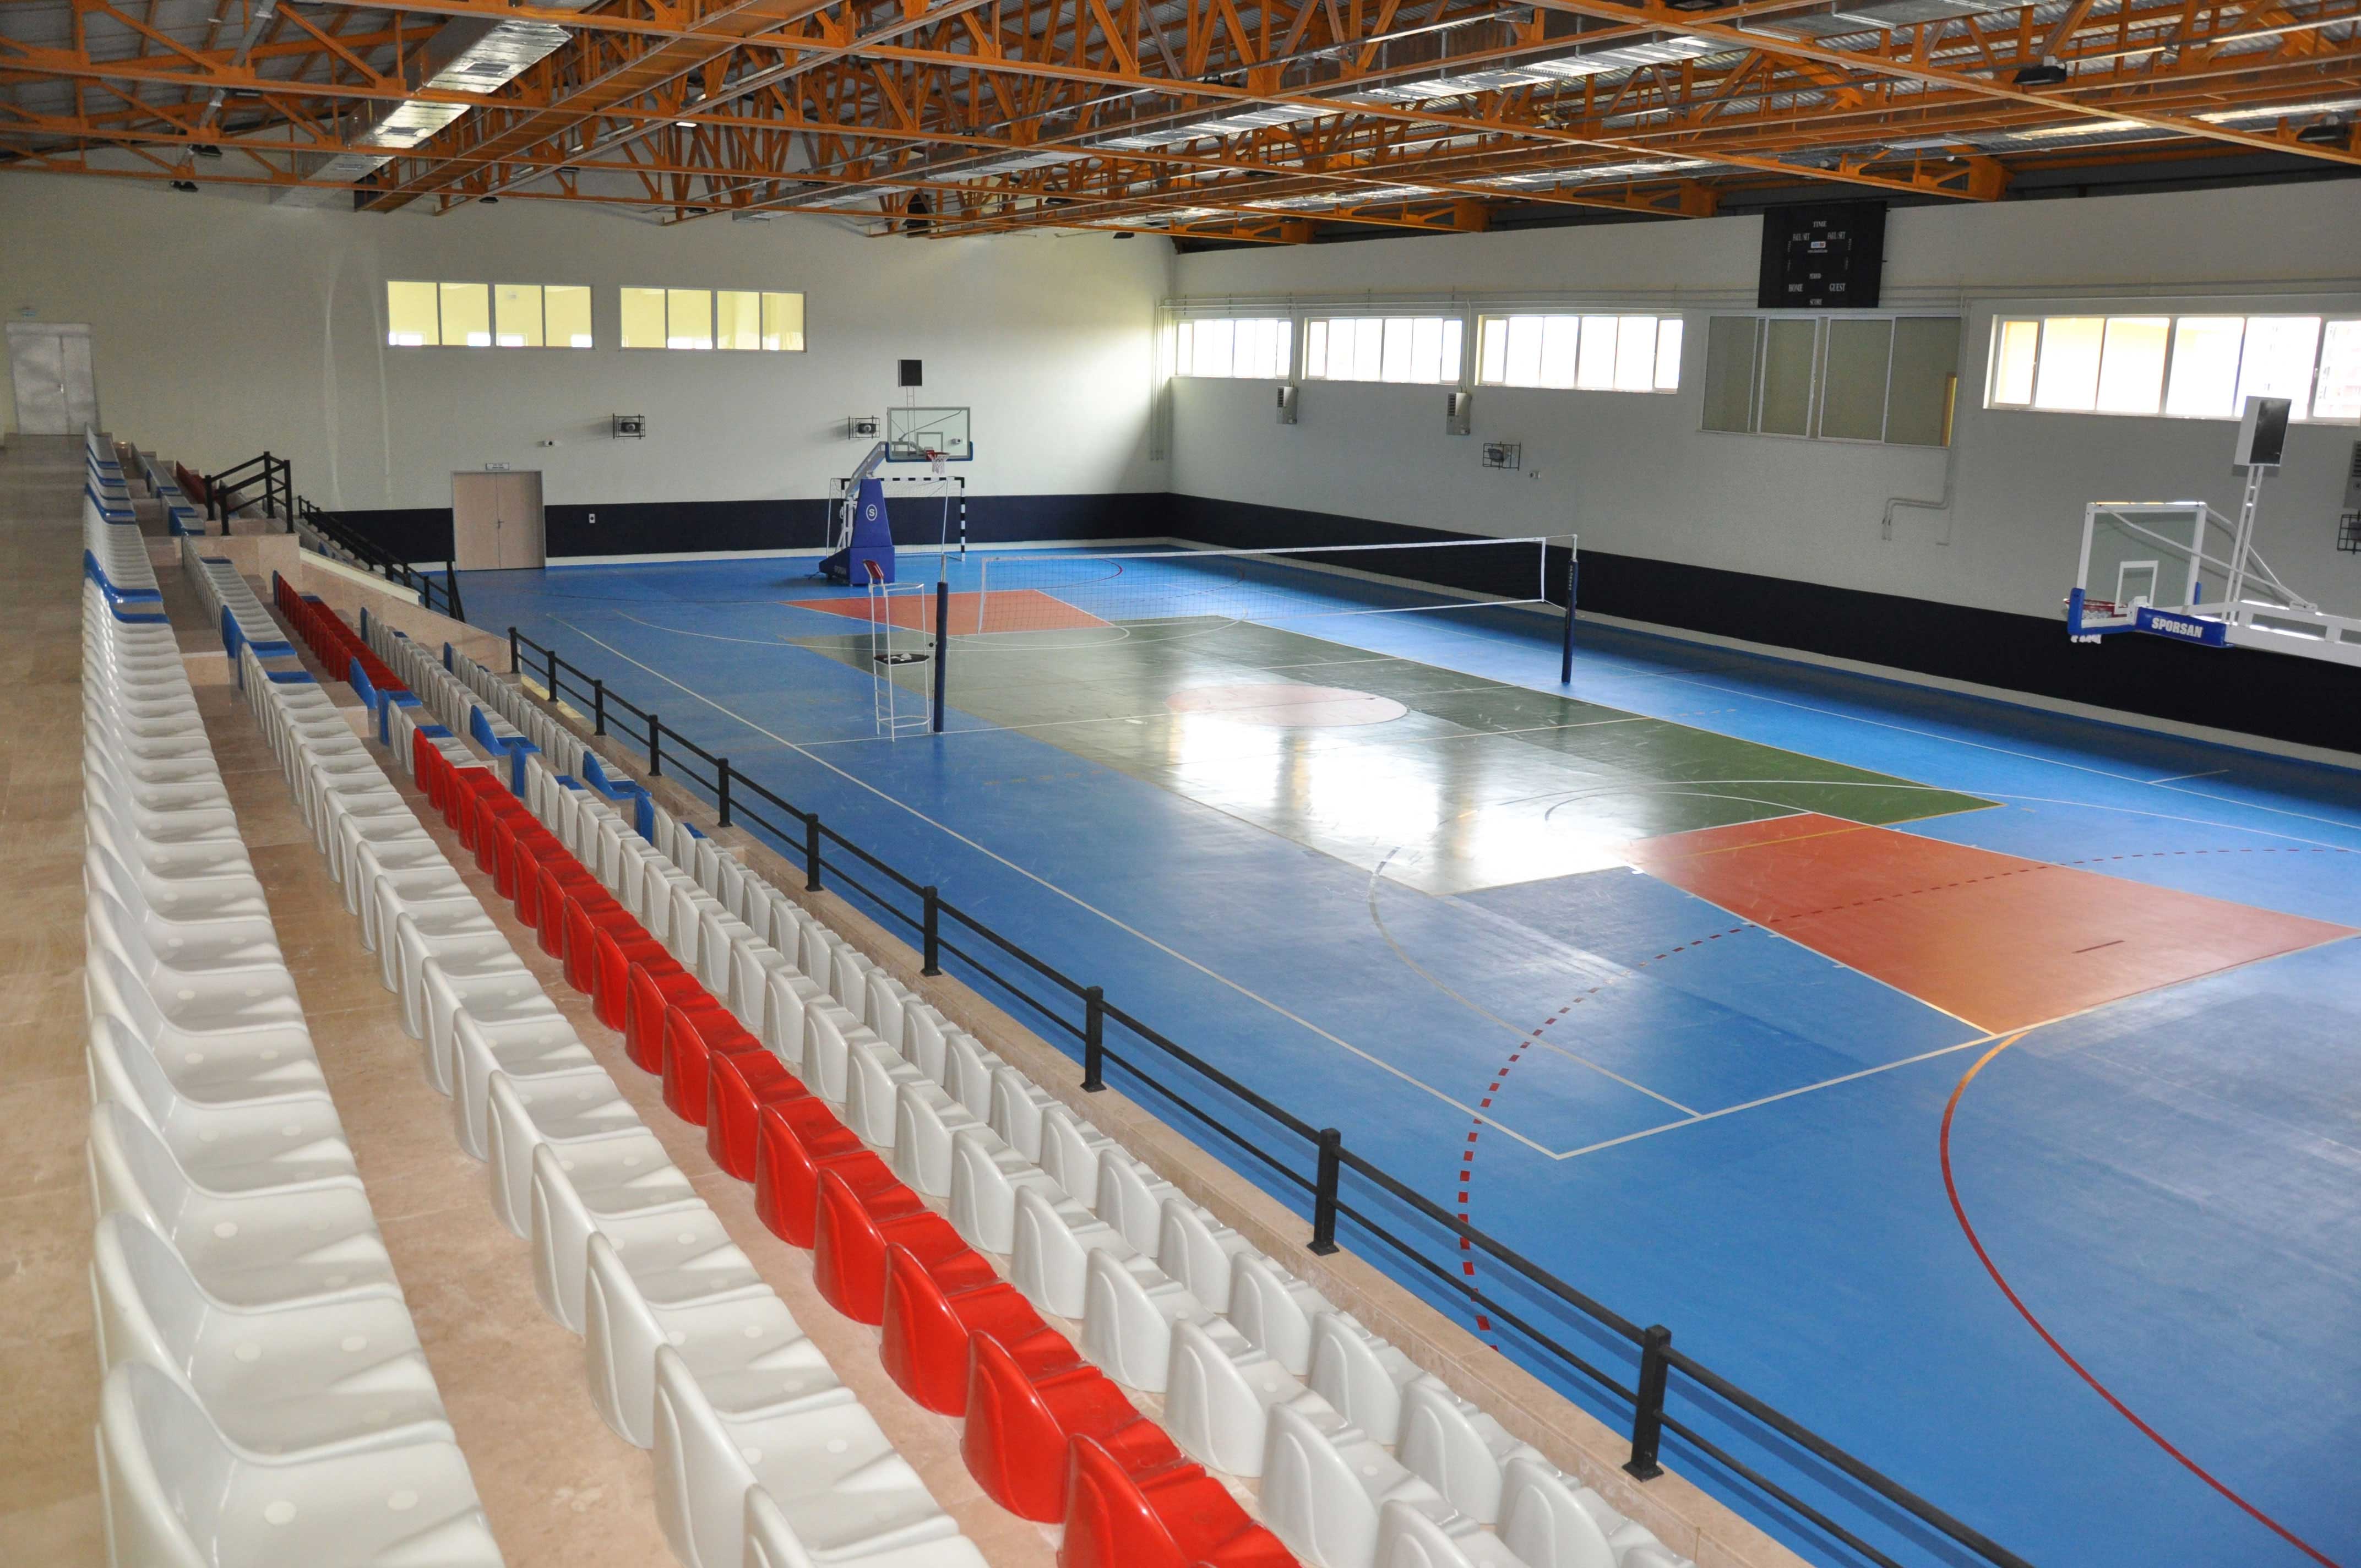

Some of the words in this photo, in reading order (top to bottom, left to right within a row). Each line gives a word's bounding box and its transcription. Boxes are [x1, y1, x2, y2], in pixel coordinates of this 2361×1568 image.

[1788, 284, 1803, 292] HOME
[1829, 283, 1846, 292] GUEST
[2151, 617, 2203, 638] SPORSAN
